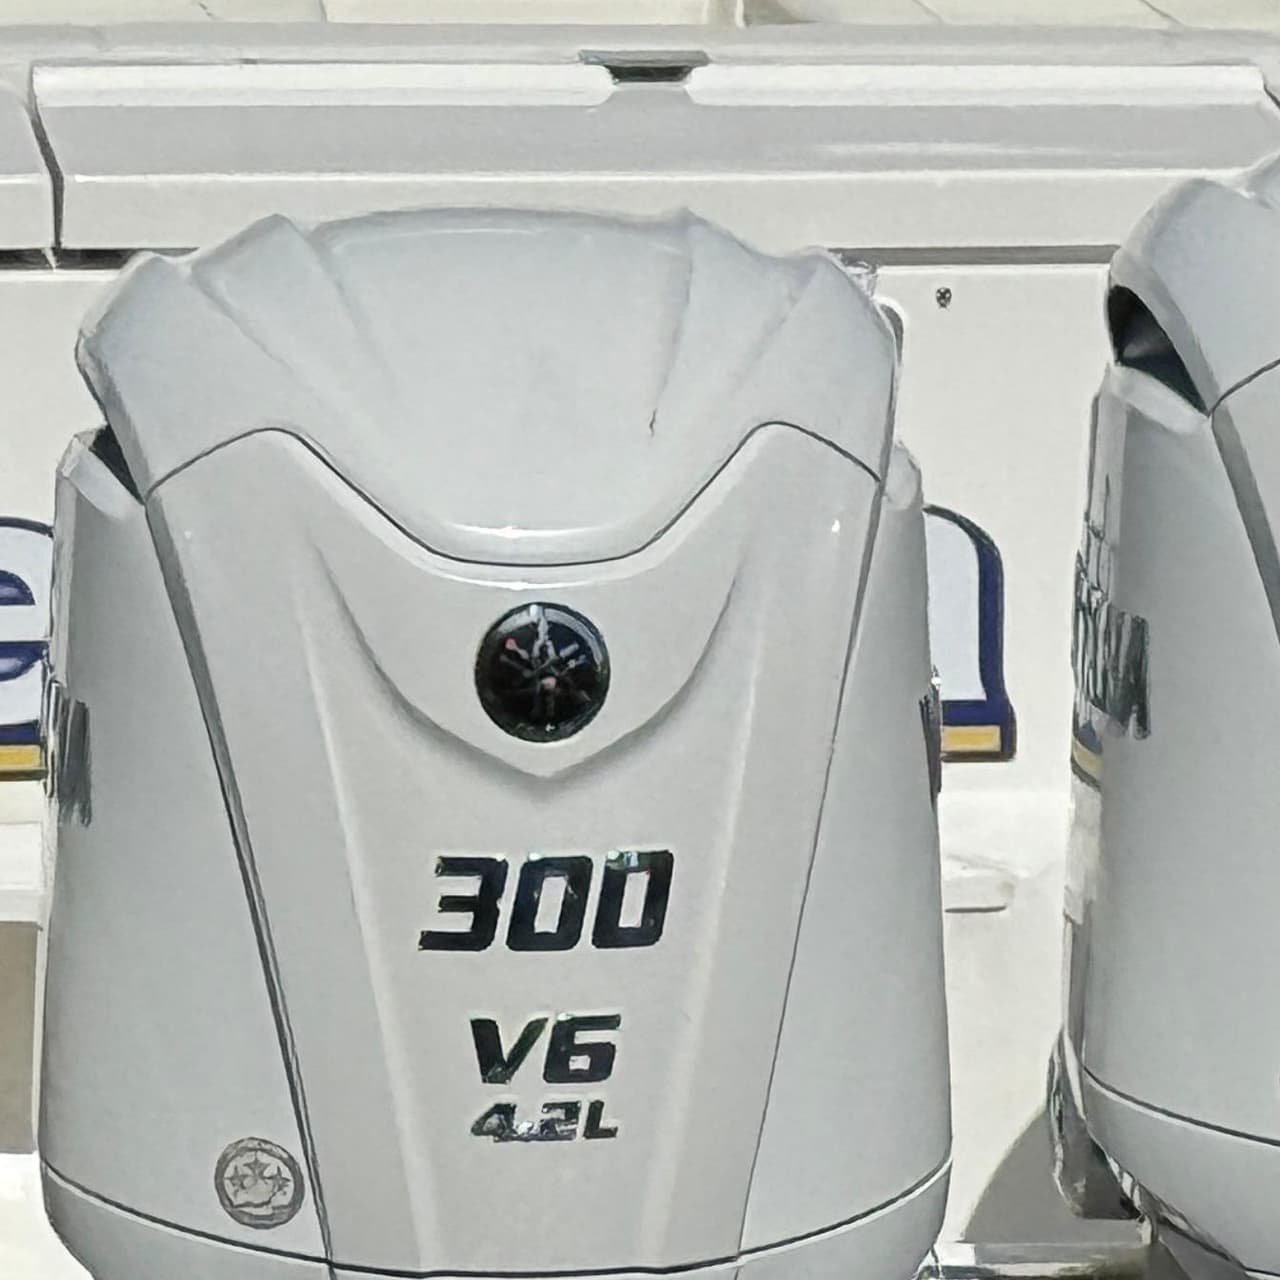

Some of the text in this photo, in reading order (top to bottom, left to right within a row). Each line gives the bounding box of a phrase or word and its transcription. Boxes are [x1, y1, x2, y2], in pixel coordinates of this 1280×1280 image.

[418, 850, 674, 951] 300
[470, 1013, 621, 1083] V6
[470, 1100, 619, 1142] 4.2L
